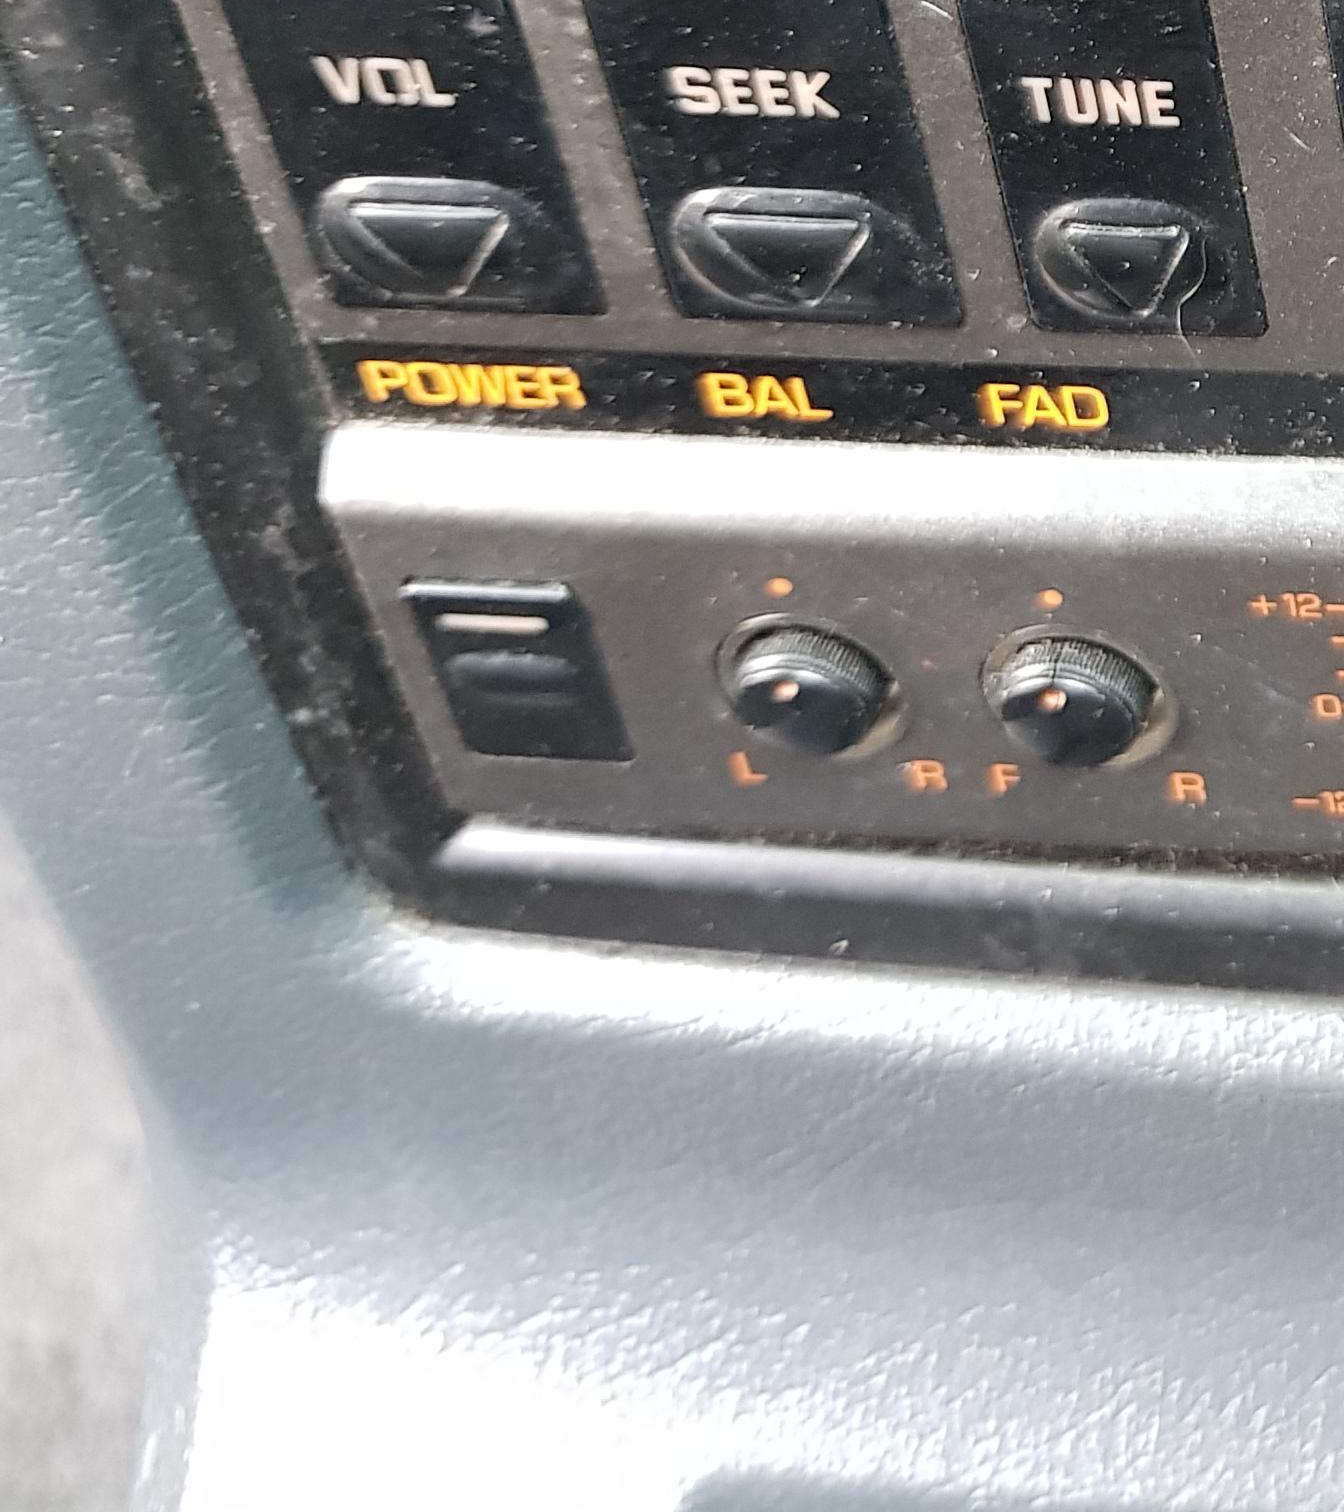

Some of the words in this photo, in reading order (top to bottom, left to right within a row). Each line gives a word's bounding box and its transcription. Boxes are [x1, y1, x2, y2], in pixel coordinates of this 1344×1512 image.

[313, 56, 456, 108] VOL
[670, 68, 840, 119] SEEK
[1022, 78, 1181, 128] TUNE
[358, 361, 588, 411] POWER
[699, 372, 834, 422] BAL
[984, 382, 1110, 431] FAD
[732, 754, 768, 786] L
[912, 761, 948, 790] R
[989, 764, 1020, 793] F
[1172, 773, 1206, 802] R
